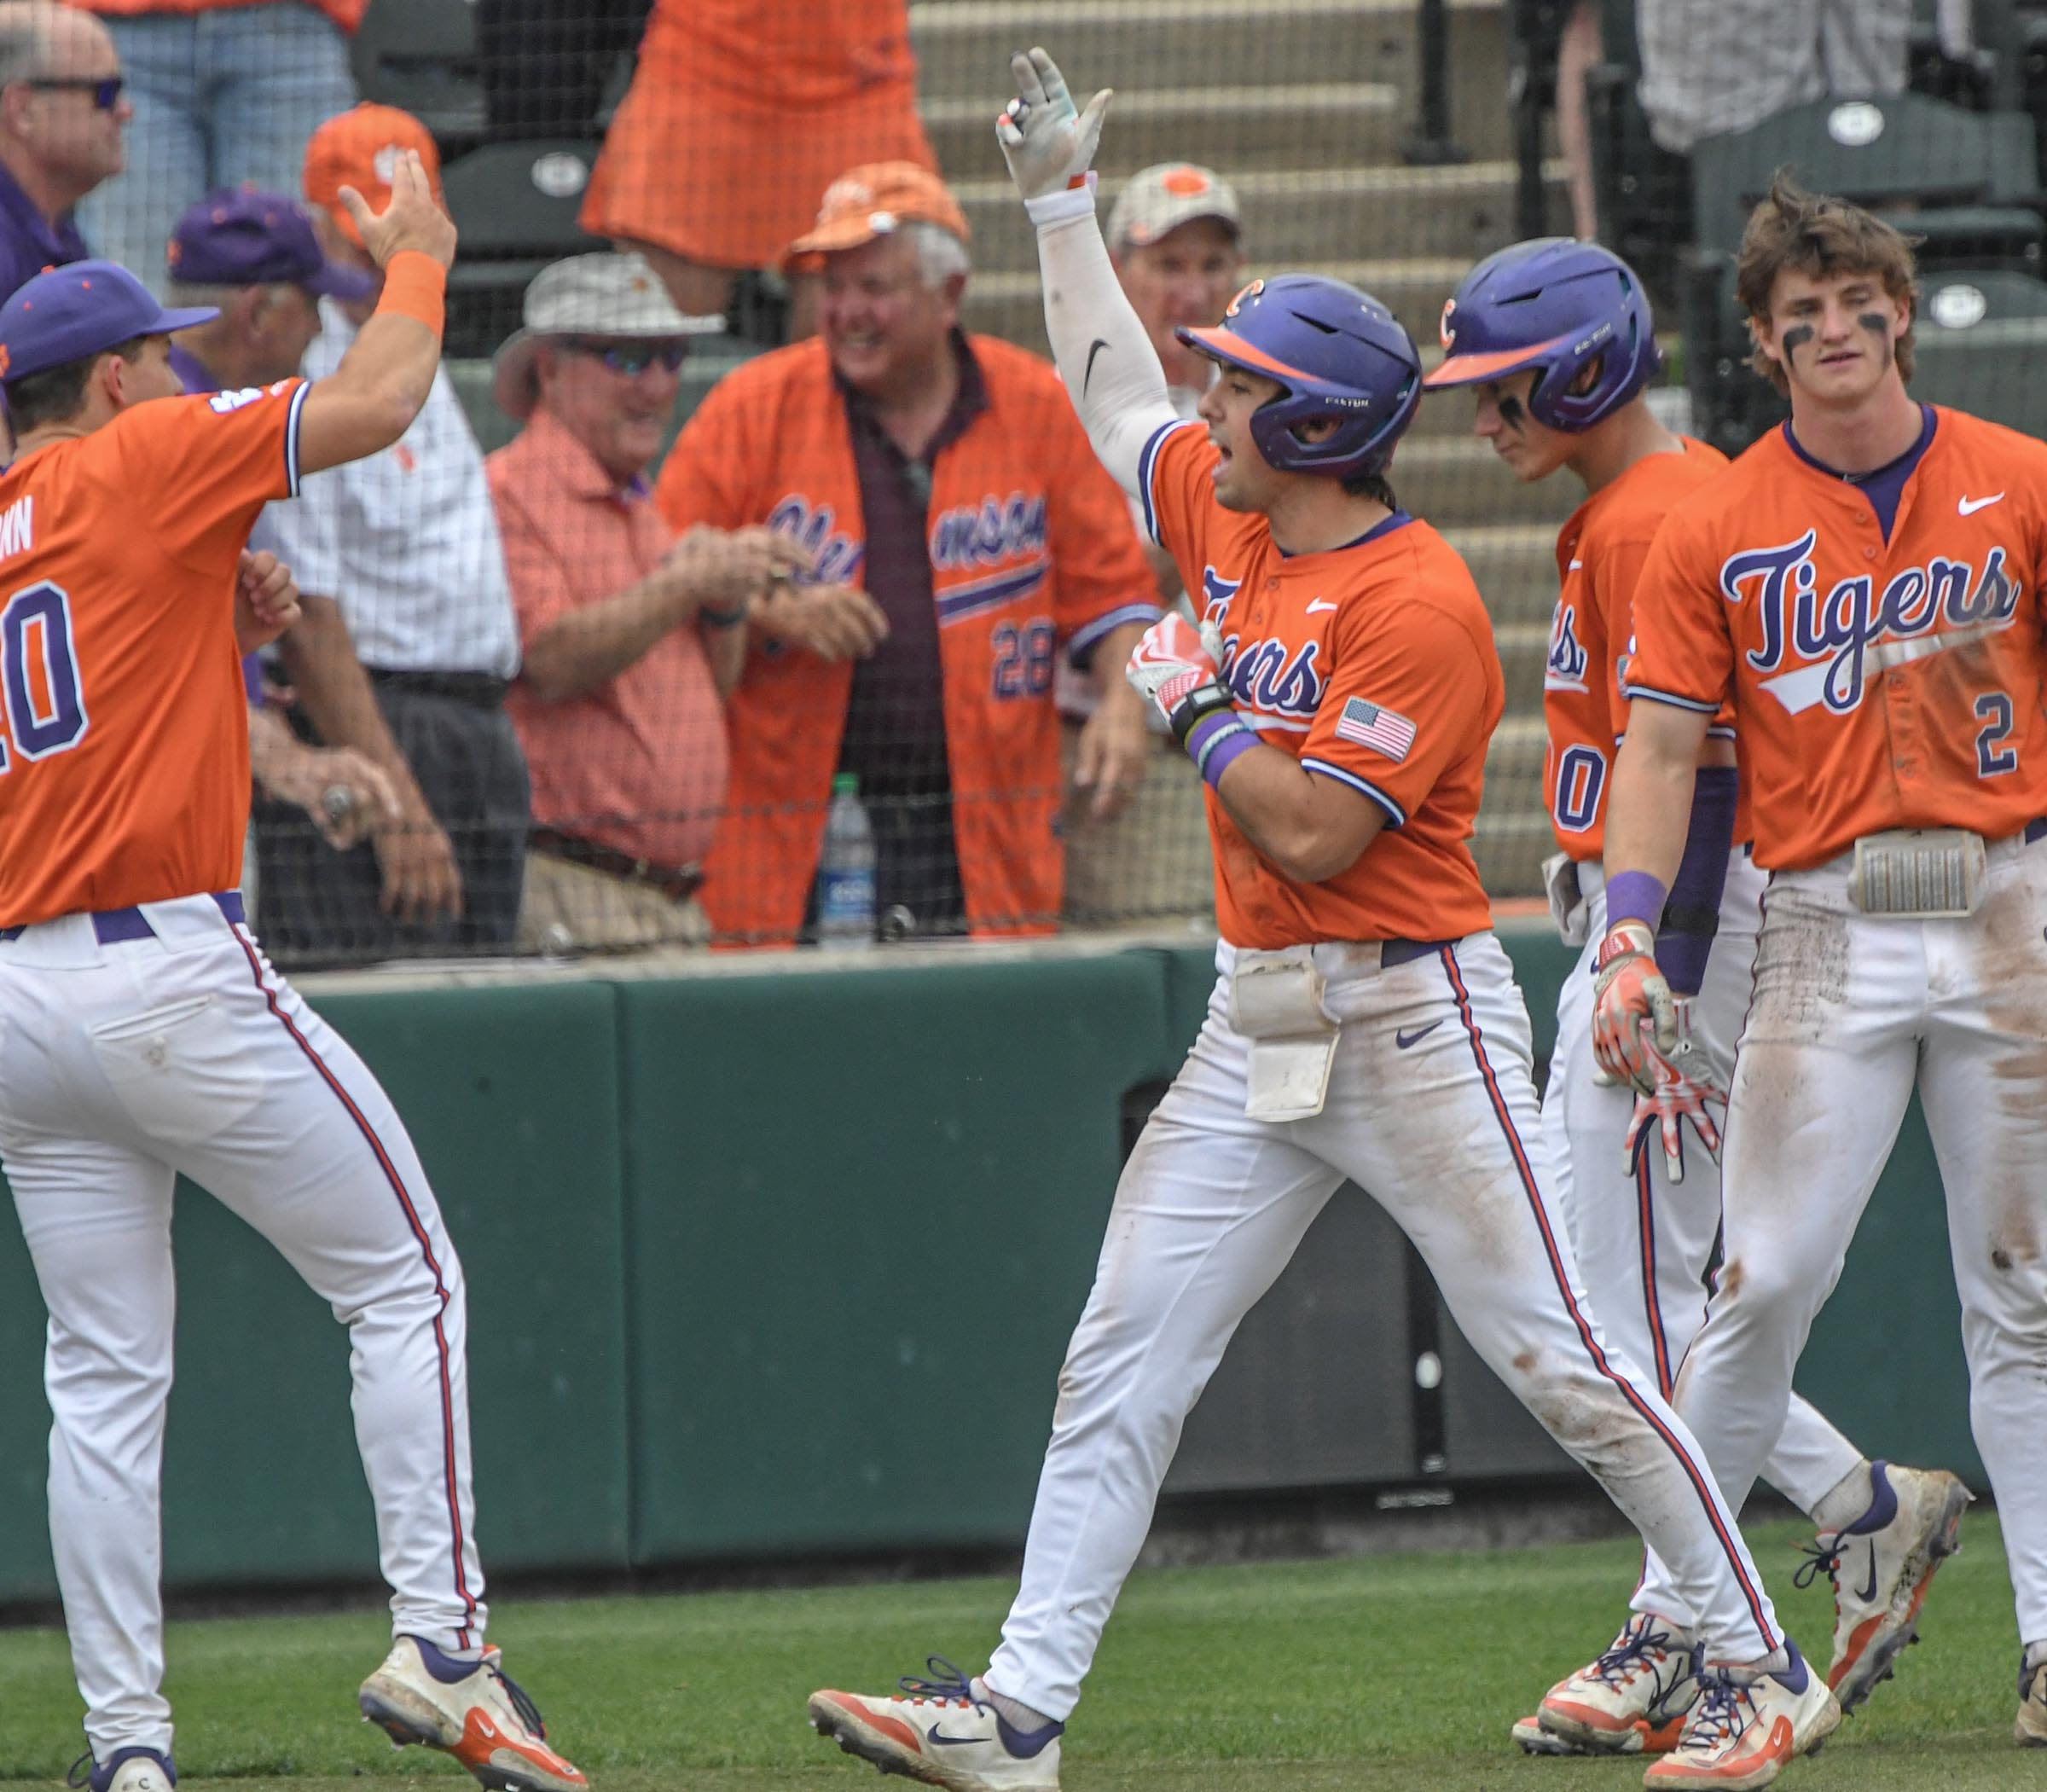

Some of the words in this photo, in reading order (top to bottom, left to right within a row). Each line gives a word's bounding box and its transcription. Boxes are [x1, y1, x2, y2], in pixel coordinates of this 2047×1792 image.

[0, 580, 90, 774] 0
[1719, 527, 2022, 715] Tigers
[1973, 692, 2018, 779] 2
